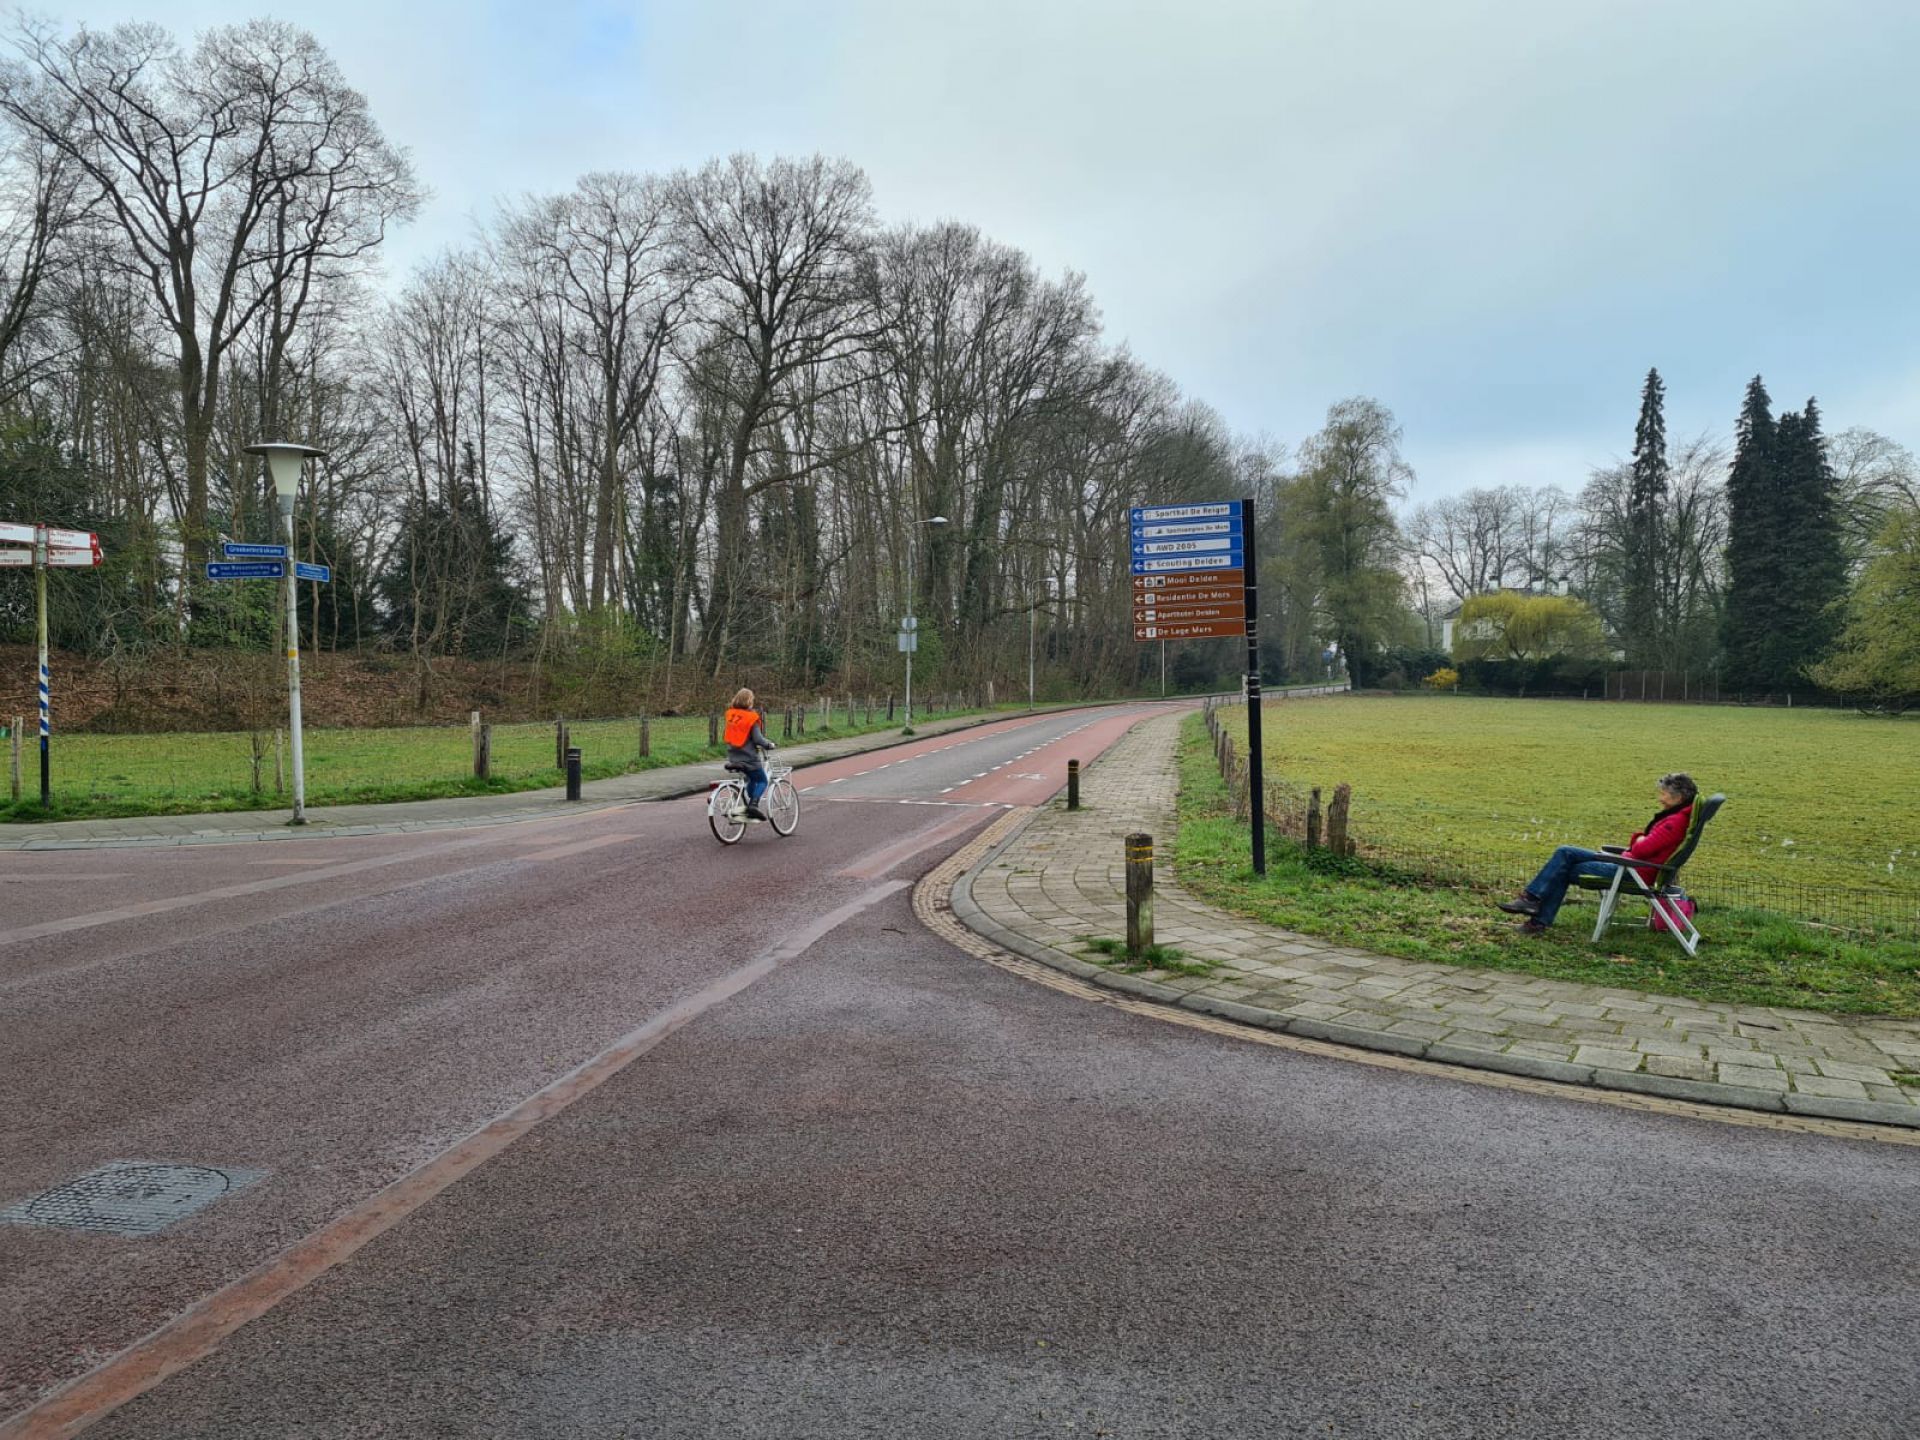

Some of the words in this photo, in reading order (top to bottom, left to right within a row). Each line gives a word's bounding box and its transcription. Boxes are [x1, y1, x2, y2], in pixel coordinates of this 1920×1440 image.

[1156, 509, 1188, 518] Sporthal
[1203, 506, 1228, 515] Reiger
[1176, 542, 1197, 550] 2005
[1156, 559, 1192, 568] Scouting
[1167, 576, 1187, 584] Mooi
[1189, 575, 1218, 583] Delden
[1156, 593, 1196, 602] Residentie
[1158, 628, 1169, 636] De
[728, 713, 743, 725] 17
